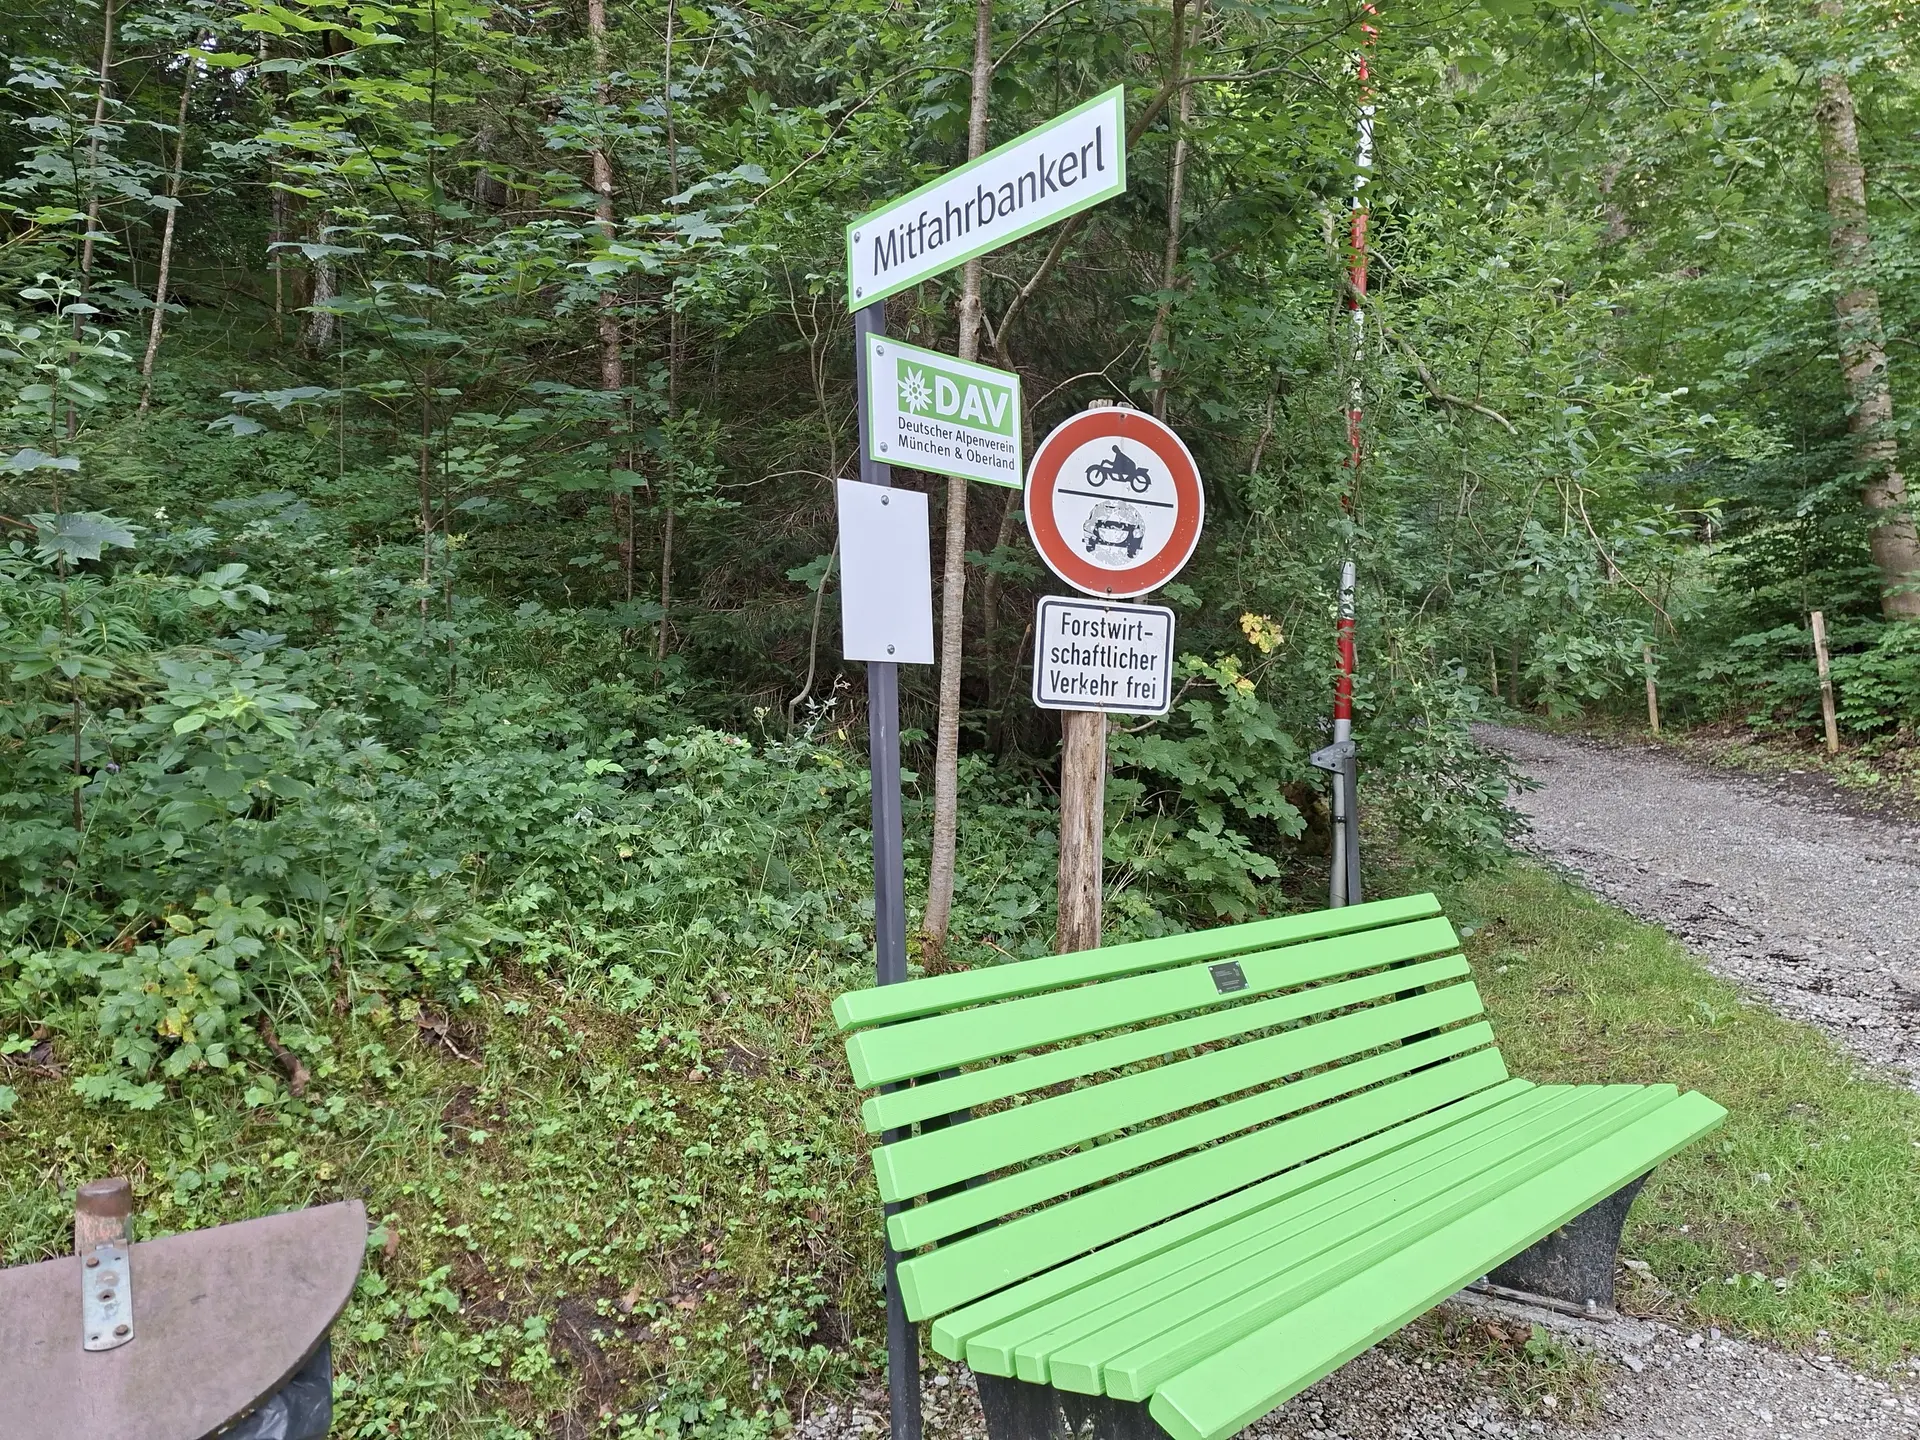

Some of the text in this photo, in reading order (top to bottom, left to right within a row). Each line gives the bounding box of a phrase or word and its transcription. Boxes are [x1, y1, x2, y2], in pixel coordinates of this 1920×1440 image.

[873, 124, 1105, 276] Mitfahrbankerl
[935, 374, 1009, 428] DAV
[898, 416, 1015, 454] Deutscher Alpenverein
[898, 433, 1015, 471] München & Oberland
[1061, 612, 1153, 642] Forstwirt-
[1050, 642, 1158, 671] schaftlicher
[1050, 669, 1156, 700] Verkehr frei
